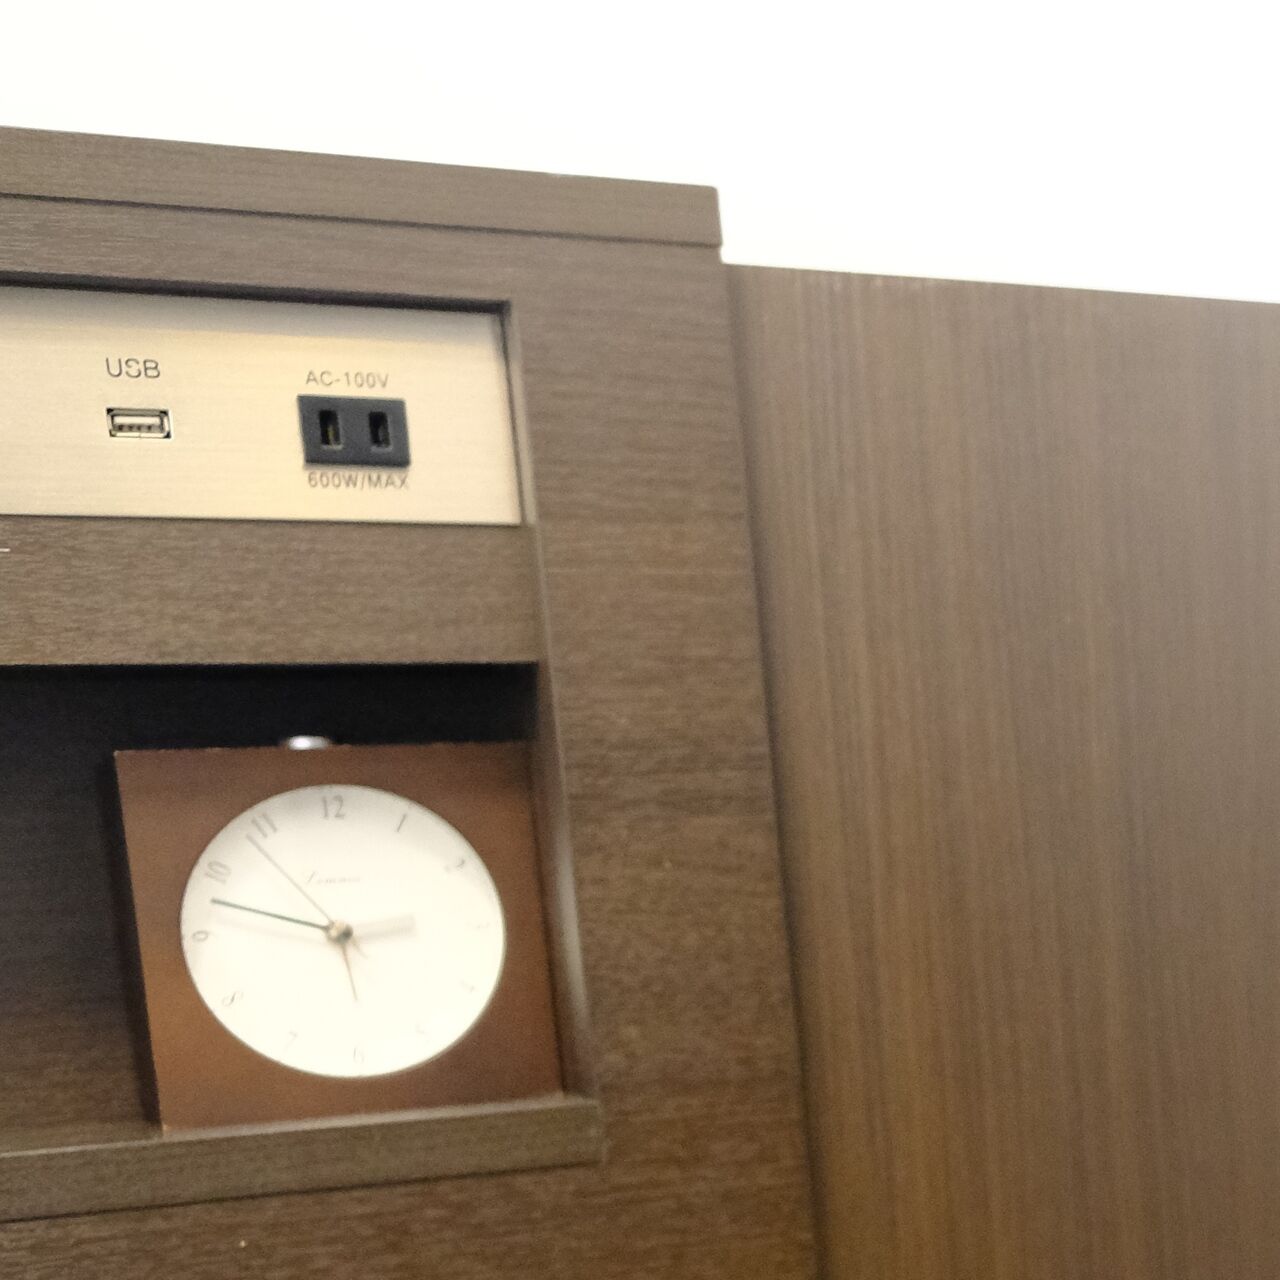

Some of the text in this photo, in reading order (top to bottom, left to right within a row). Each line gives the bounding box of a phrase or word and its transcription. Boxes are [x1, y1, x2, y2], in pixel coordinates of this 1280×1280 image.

[106, 357, 161, 379] USB
[305, 369, 390, 389] AC-100V
[308, 471, 409, 490] 600W/MAX
[320, 795, 346, 820] 12
[250, 812, 279, 838] 11
[393, 813, 408, 833] 1
[204, 860, 232, 885] 10
